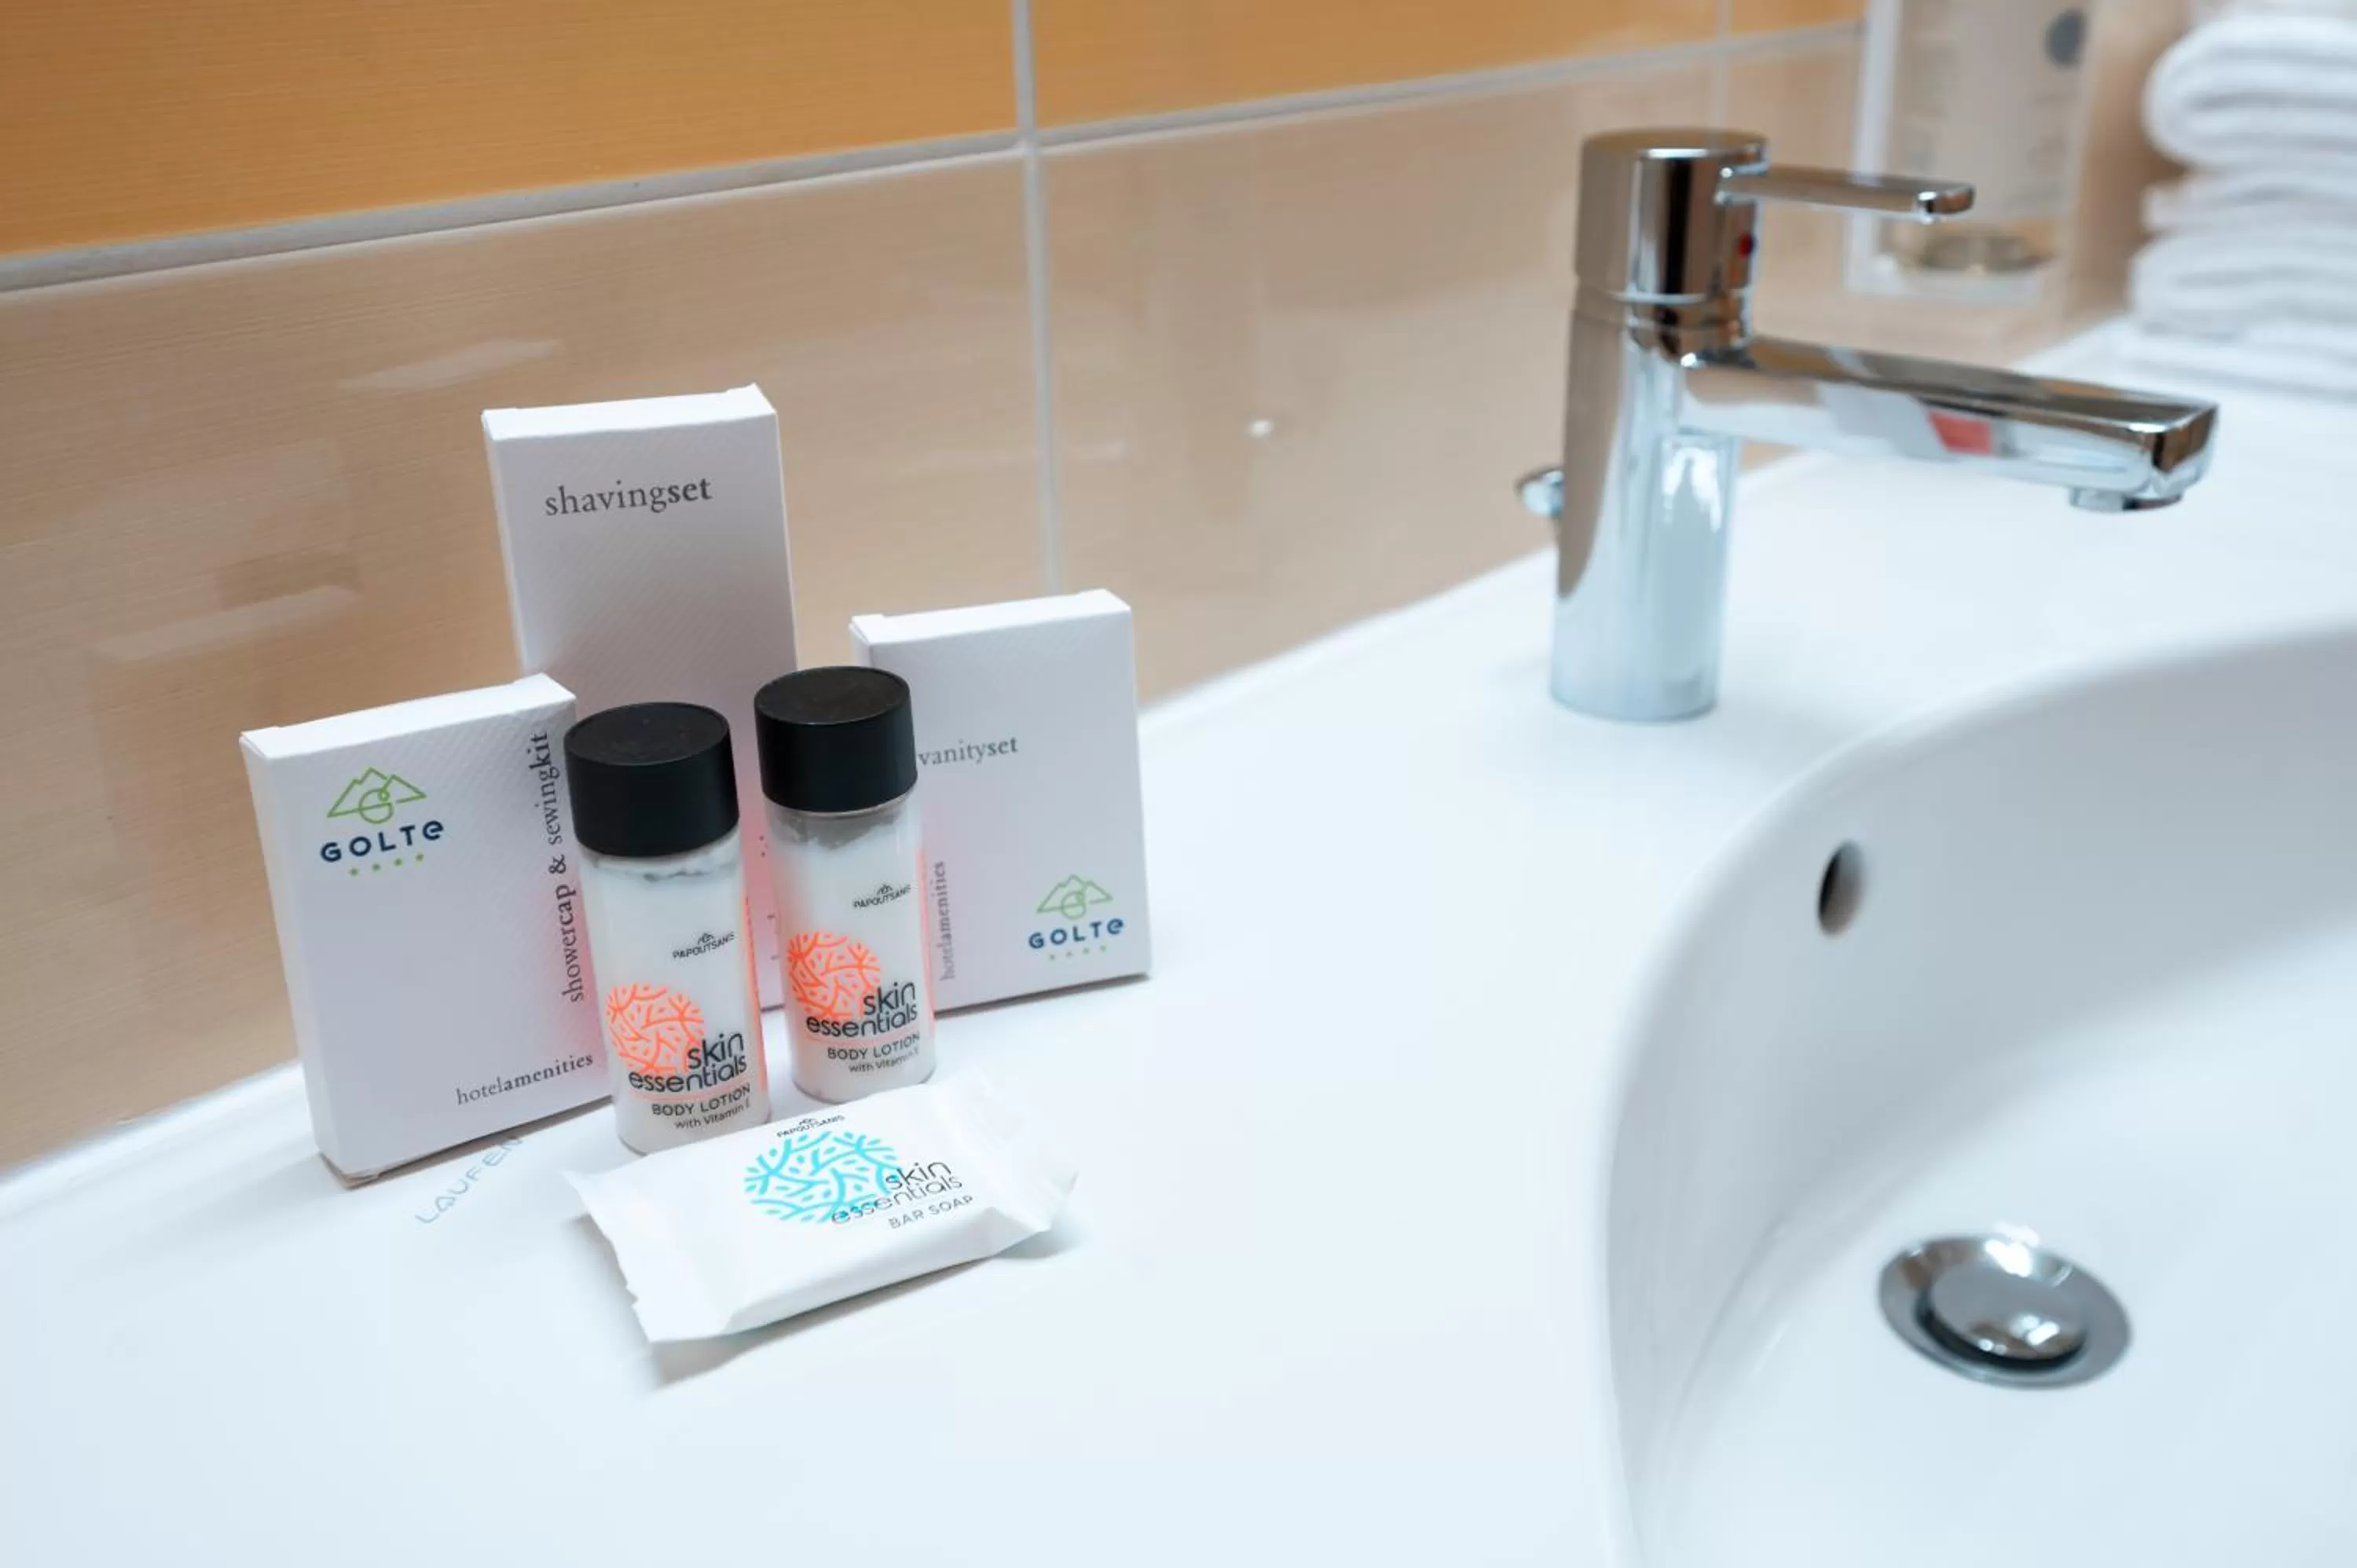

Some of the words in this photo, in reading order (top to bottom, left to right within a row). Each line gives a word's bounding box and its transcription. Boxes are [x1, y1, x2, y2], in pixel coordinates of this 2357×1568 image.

[545, 478, 713, 515] shavingset
[918, 736, 1019, 766] vanityset
[527, 731, 563, 846] sewingkit
[548, 854, 567, 875] &
[555, 883, 585, 1003] showercap
[863, 981, 916, 1016] skin
[806, 1003, 918, 1038] essentials
[687, 1032, 745, 1070] skin
[827, 1047, 868, 1061] BODY
[873, 1031, 920, 1058] LOTION
[456, 1053, 594, 1106] hotelamenities
[629, 1055, 747, 1094] essentials
[849, 1061, 874, 1073] with
[651, 1103, 695, 1117] BODY
[700, 1083, 751, 1113] LOTION
[674, 1116, 702, 1130] with
[415, 1135, 523, 1223] LAUFEN
[885, 1161, 951, 1190] skin
[831, 1174, 963, 1225] essentials
[889, 1208, 924, 1229] BAR
[929, 1194, 973, 1216] SOAP
